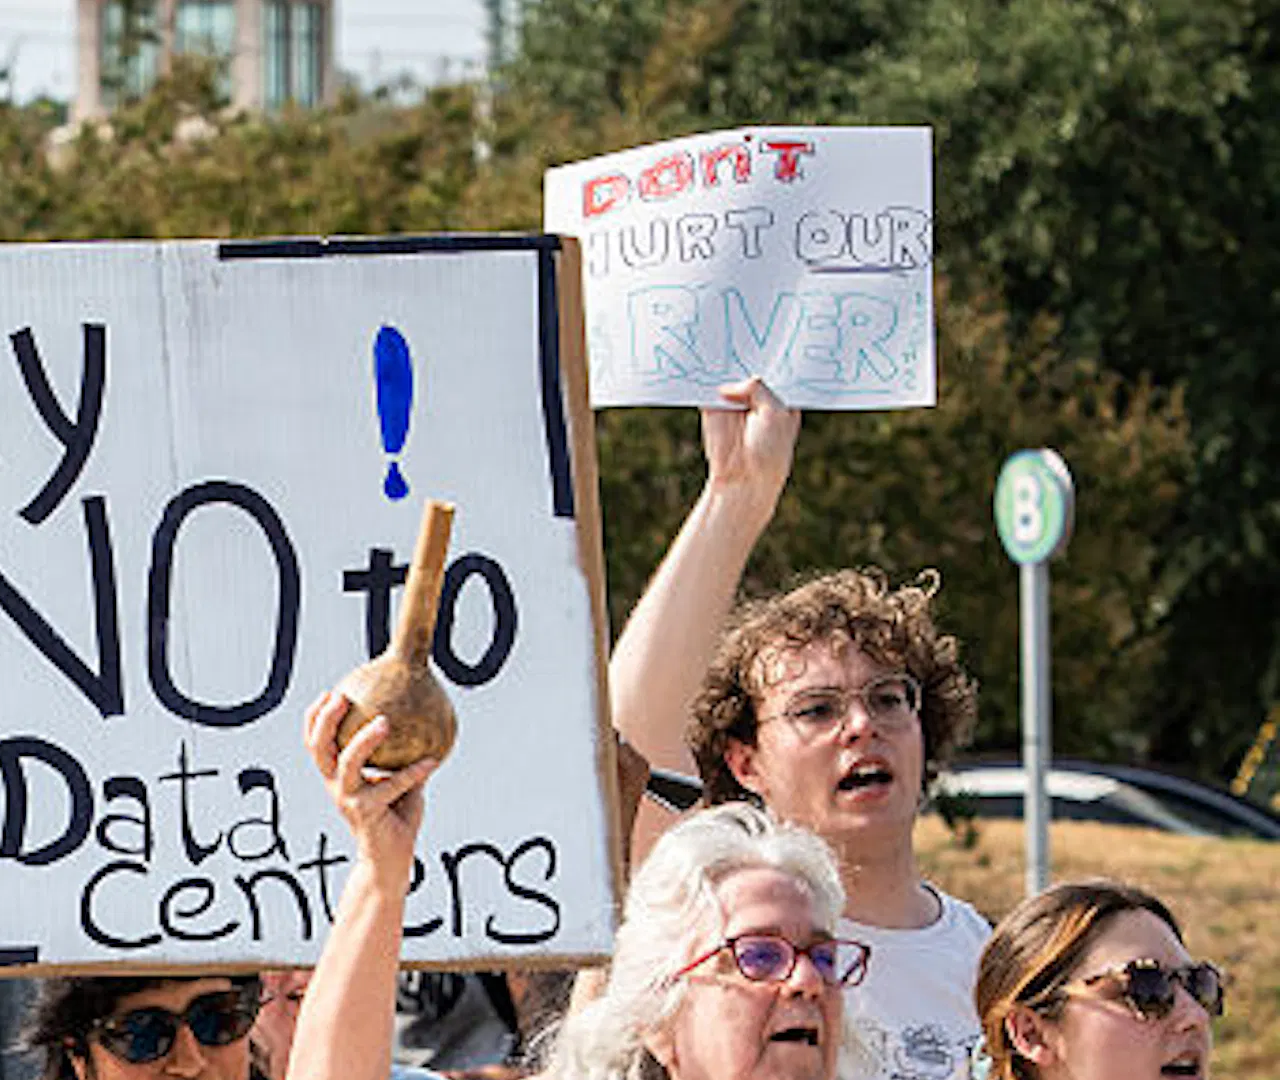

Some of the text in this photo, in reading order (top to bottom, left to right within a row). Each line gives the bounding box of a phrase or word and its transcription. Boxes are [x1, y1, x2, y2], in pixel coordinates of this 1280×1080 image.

[796, 205, 932, 272] OUR
[1012, 475, 1043, 542] B
[343, 547, 518, 688] to
